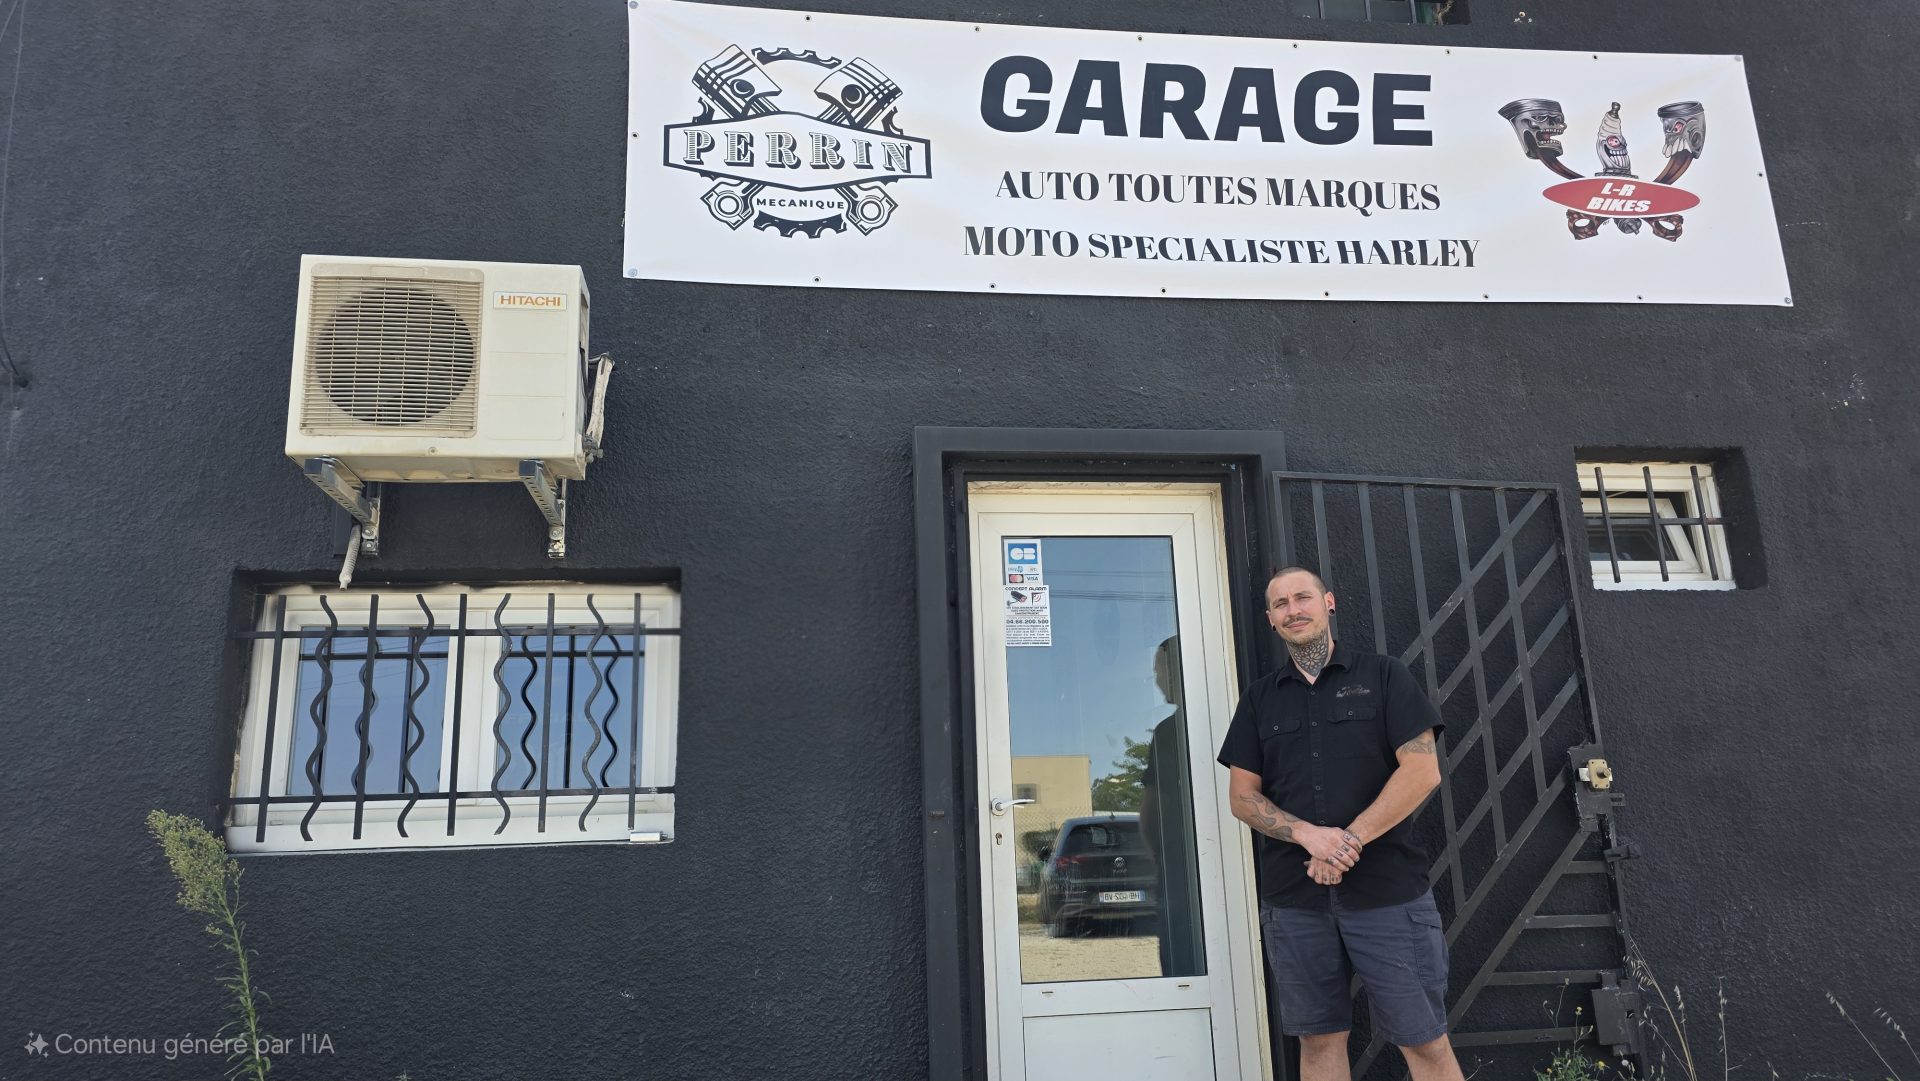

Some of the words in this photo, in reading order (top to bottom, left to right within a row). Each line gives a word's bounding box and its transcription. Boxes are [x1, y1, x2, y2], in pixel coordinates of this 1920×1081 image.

[979, 55, 1433, 146] GARAGE
[683, 129, 913, 174] PERRIN
[756, 197, 845, 211] MECANIQUE
[996, 170, 1100, 202] AUTO
[1108, 173, 1257, 206] TOUTES
[1265, 177, 1441, 217] MARQUES
[1600, 182, 1636, 197] L-R
[1586, 197, 1652, 212] BIKES
[963, 225, 1079, 258] MOTO
[1087, 232, 1330, 264] SPECIALISTE
[1336, 238, 1480, 268] HARLEY
[500, 295, 561, 306] HITACHI
